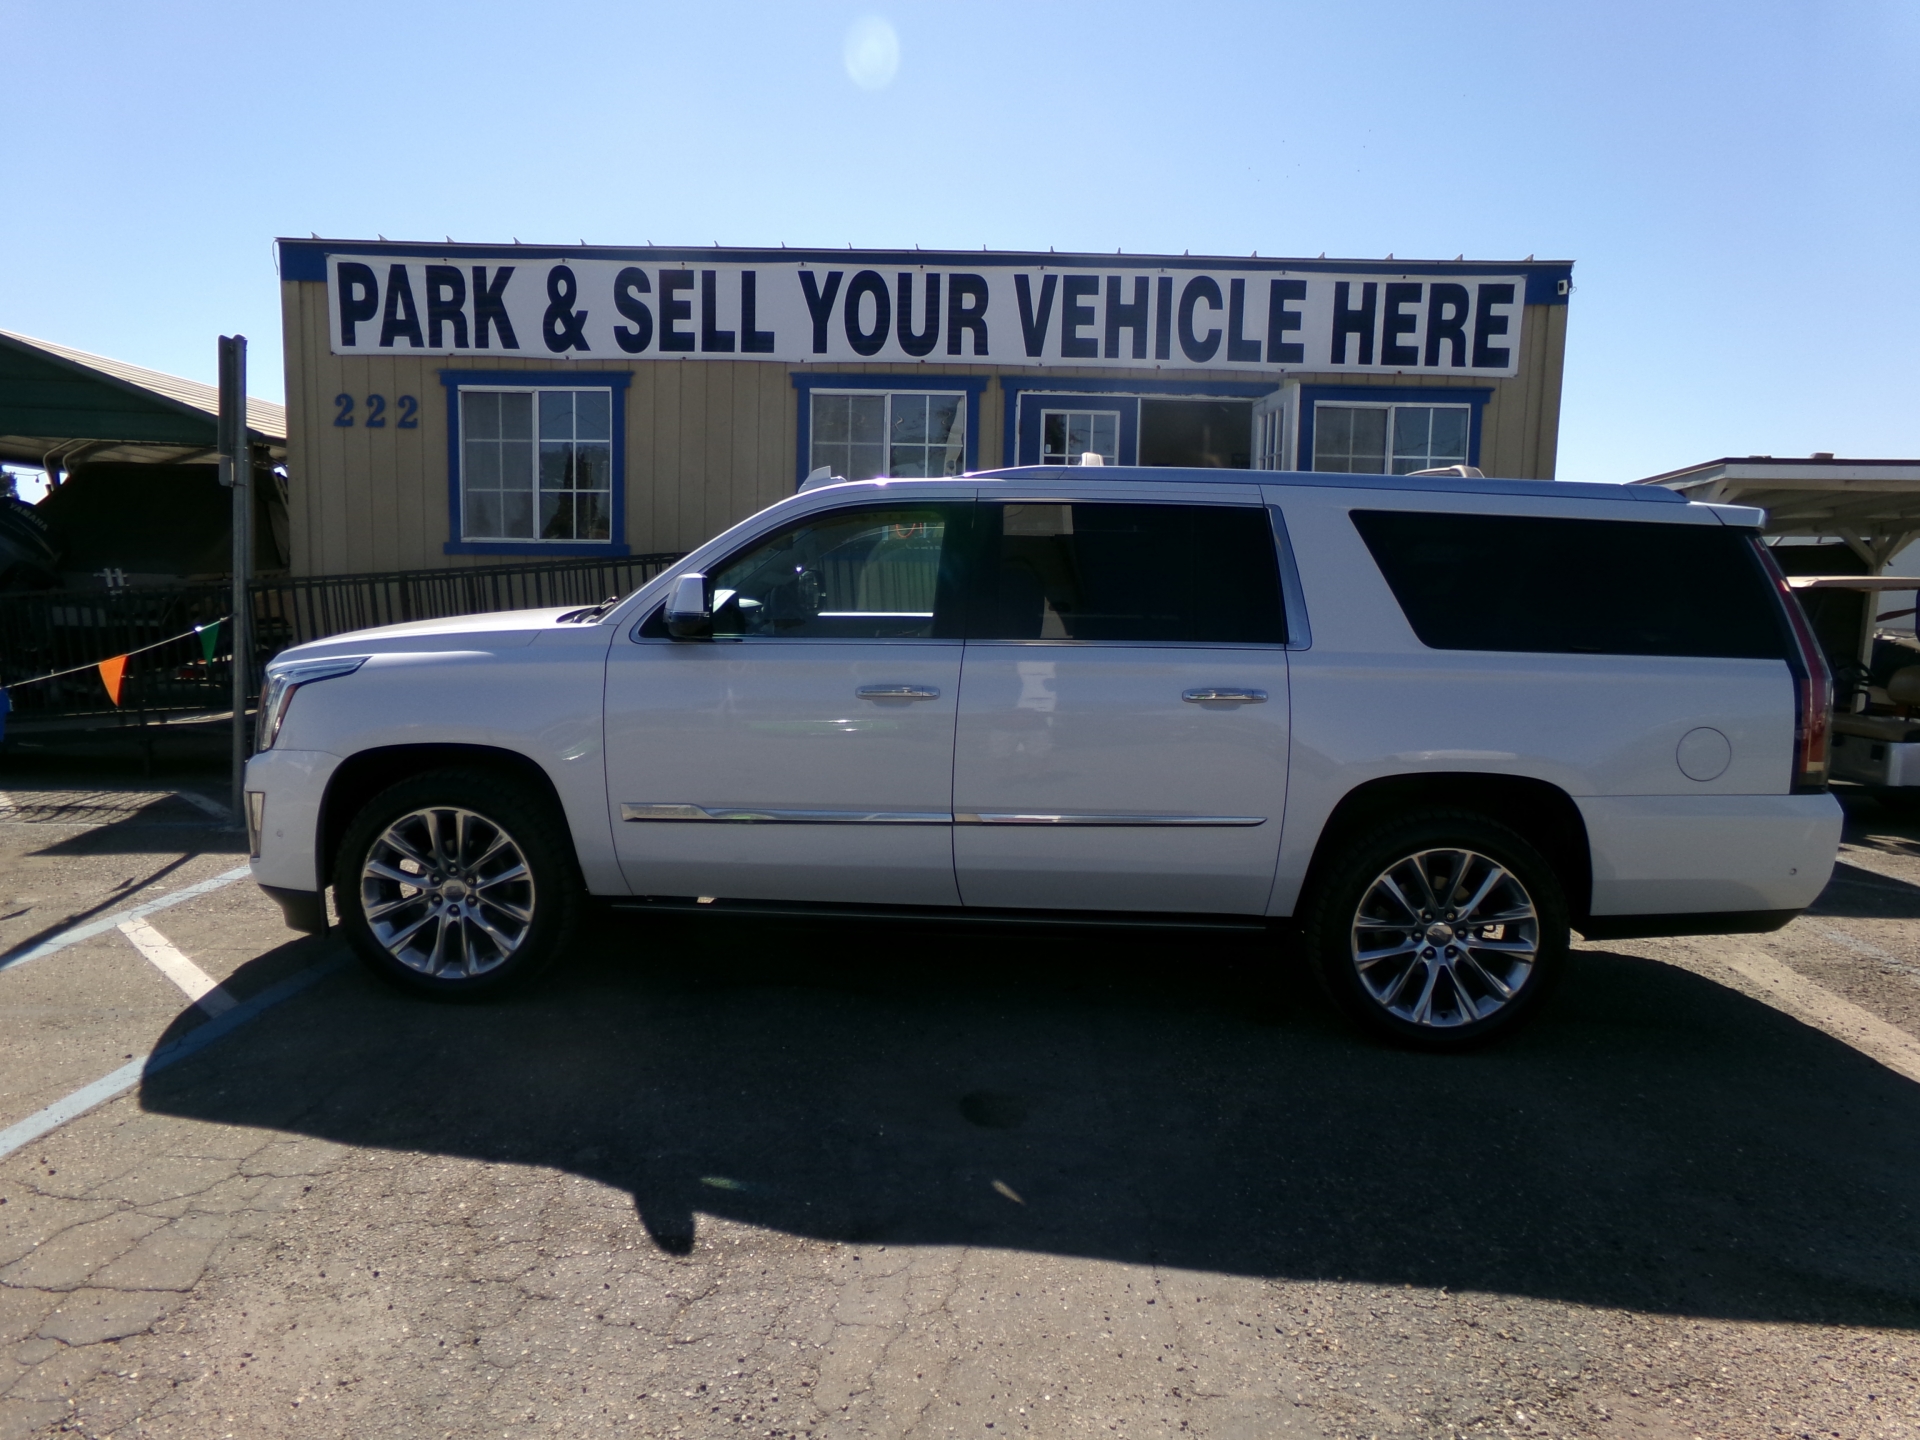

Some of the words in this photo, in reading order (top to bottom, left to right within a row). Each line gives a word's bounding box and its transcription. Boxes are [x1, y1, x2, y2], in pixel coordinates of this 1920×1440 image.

[336, 261, 520, 350] PARK
[542, 264, 591, 354] &
[613, 266, 775, 354] SELL
[797, 270, 989, 357] YOUR
[1013, 274, 1307, 364] VEHICLE
[1330, 281, 1516, 369] HERE
[333, 392, 419, 430] 222
[9, 502, 48, 532] YAMAHA
